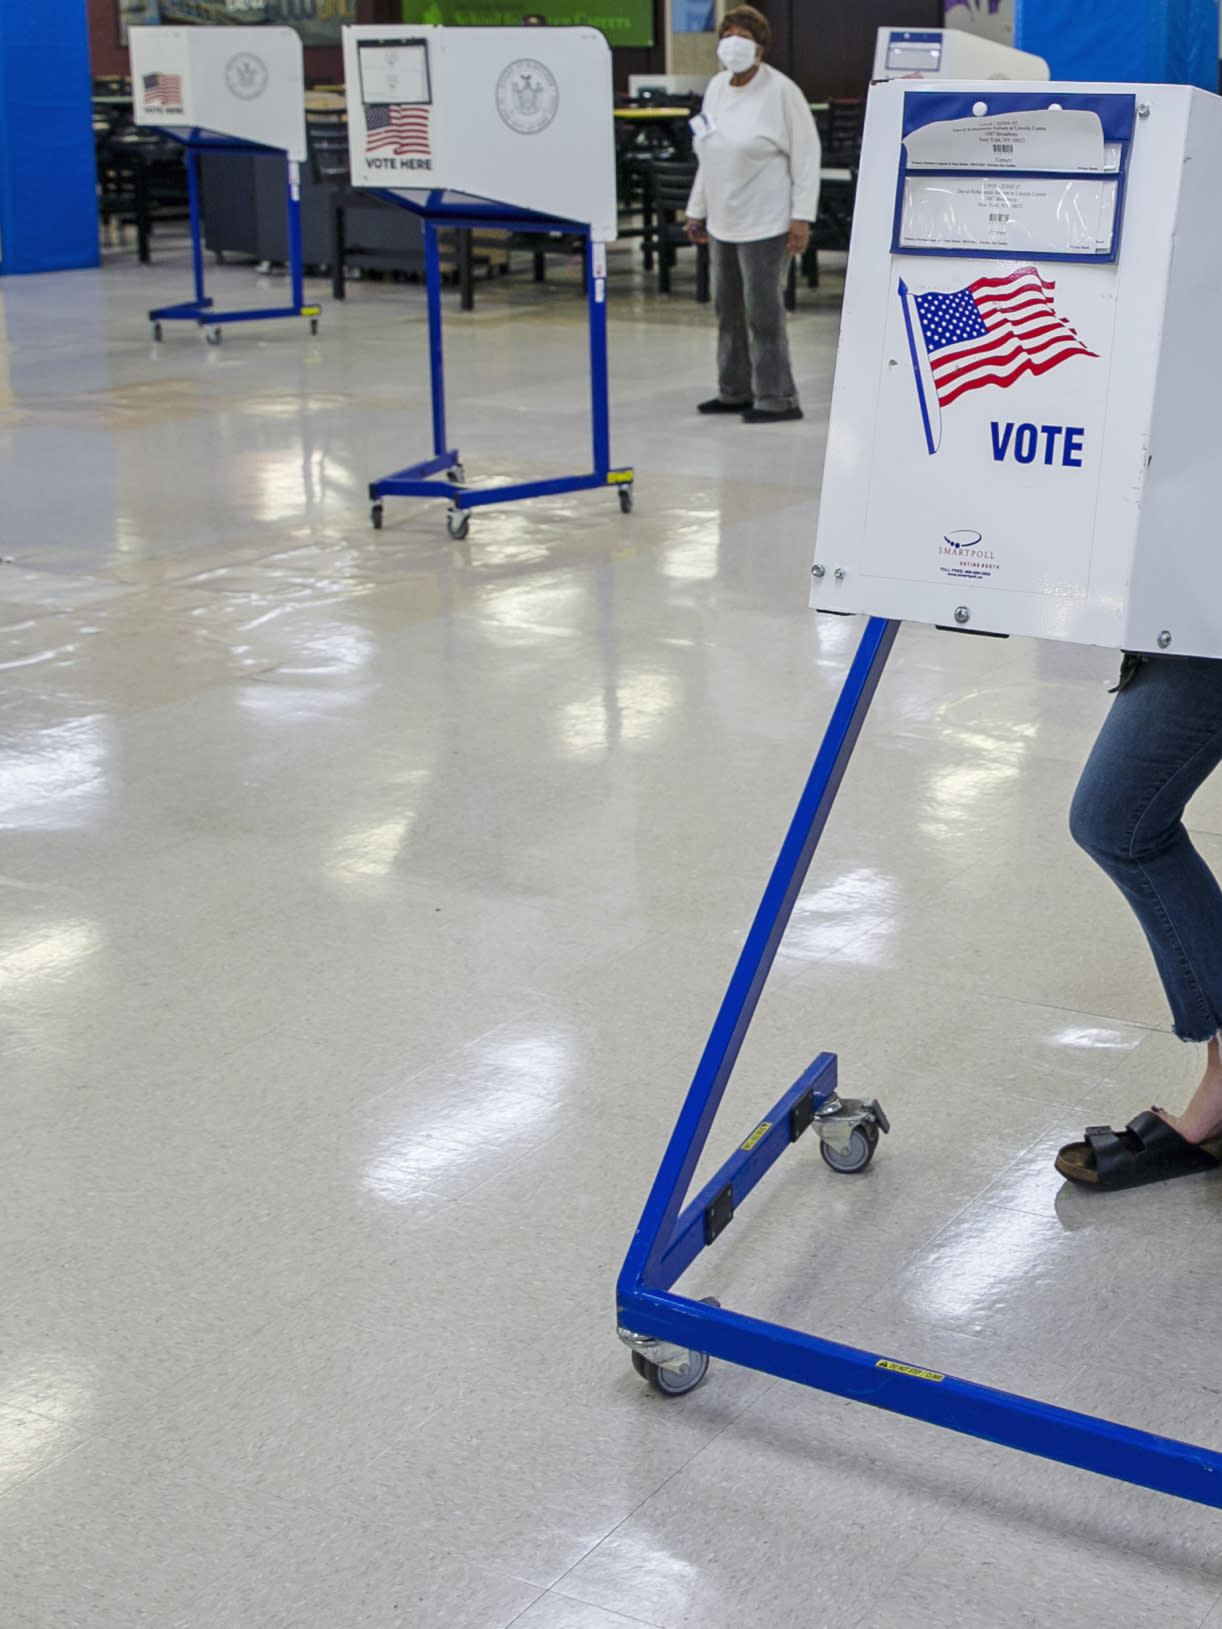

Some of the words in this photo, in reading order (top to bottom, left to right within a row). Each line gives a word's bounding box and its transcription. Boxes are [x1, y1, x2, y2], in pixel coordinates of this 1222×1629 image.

[366, 157, 397, 169] VOTE
[400, 158, 432, 171] HERE
[990, 421, 1085, 467] VOTE
[938, 546, 995, 560] SMARTPOLL
